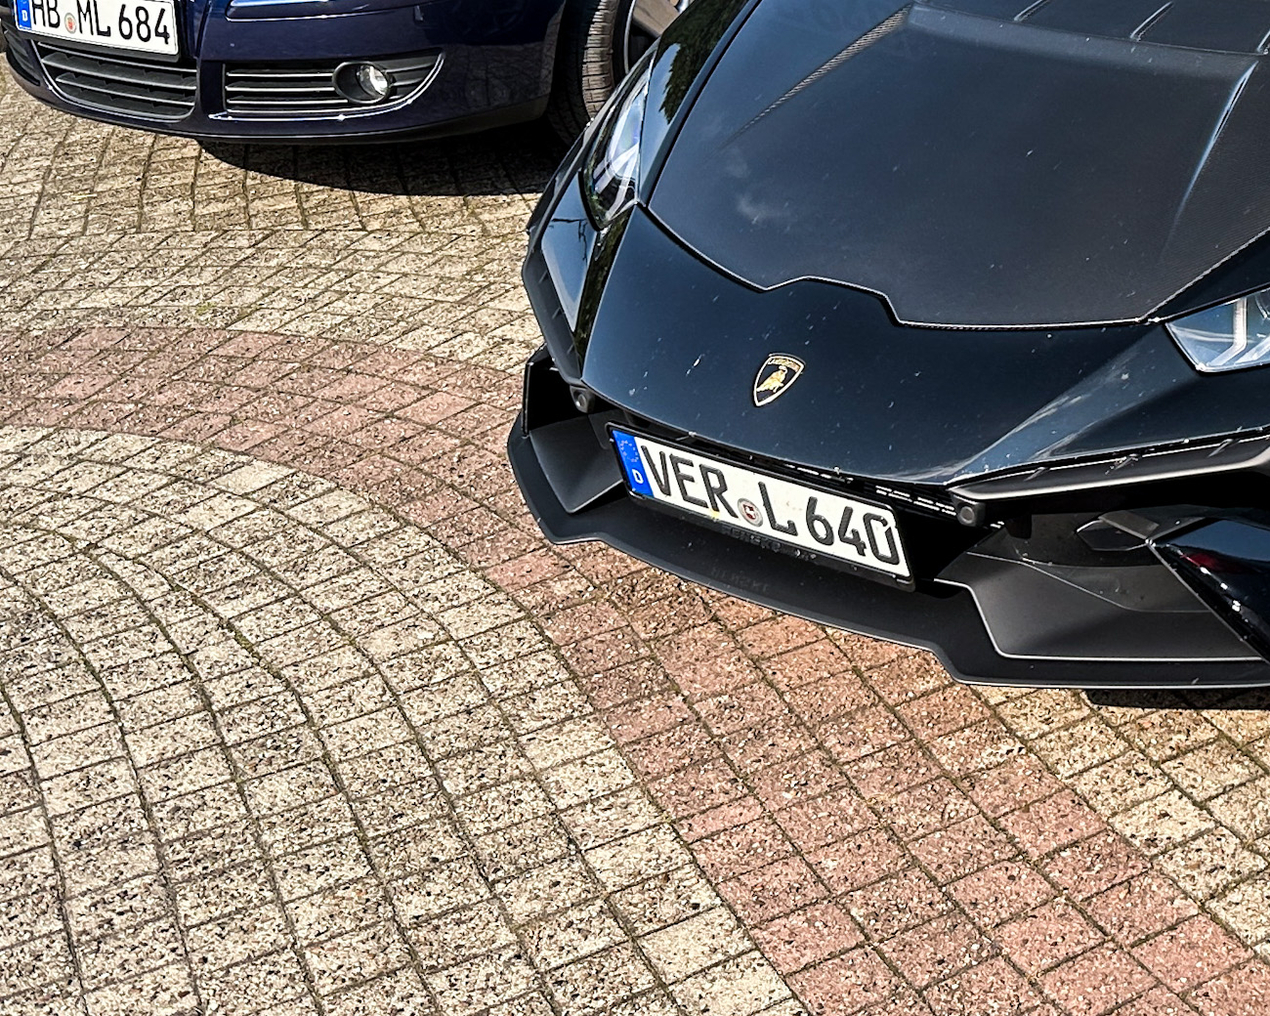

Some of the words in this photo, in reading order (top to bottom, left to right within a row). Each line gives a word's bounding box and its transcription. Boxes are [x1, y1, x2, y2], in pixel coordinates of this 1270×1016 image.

[118, 4, 171, 45] 684
[631, 468, 644, 484] D
[640, 445, 738, 519] VER
[758, 481, 799, 537] L
[806, 496, 900, 566] 640
